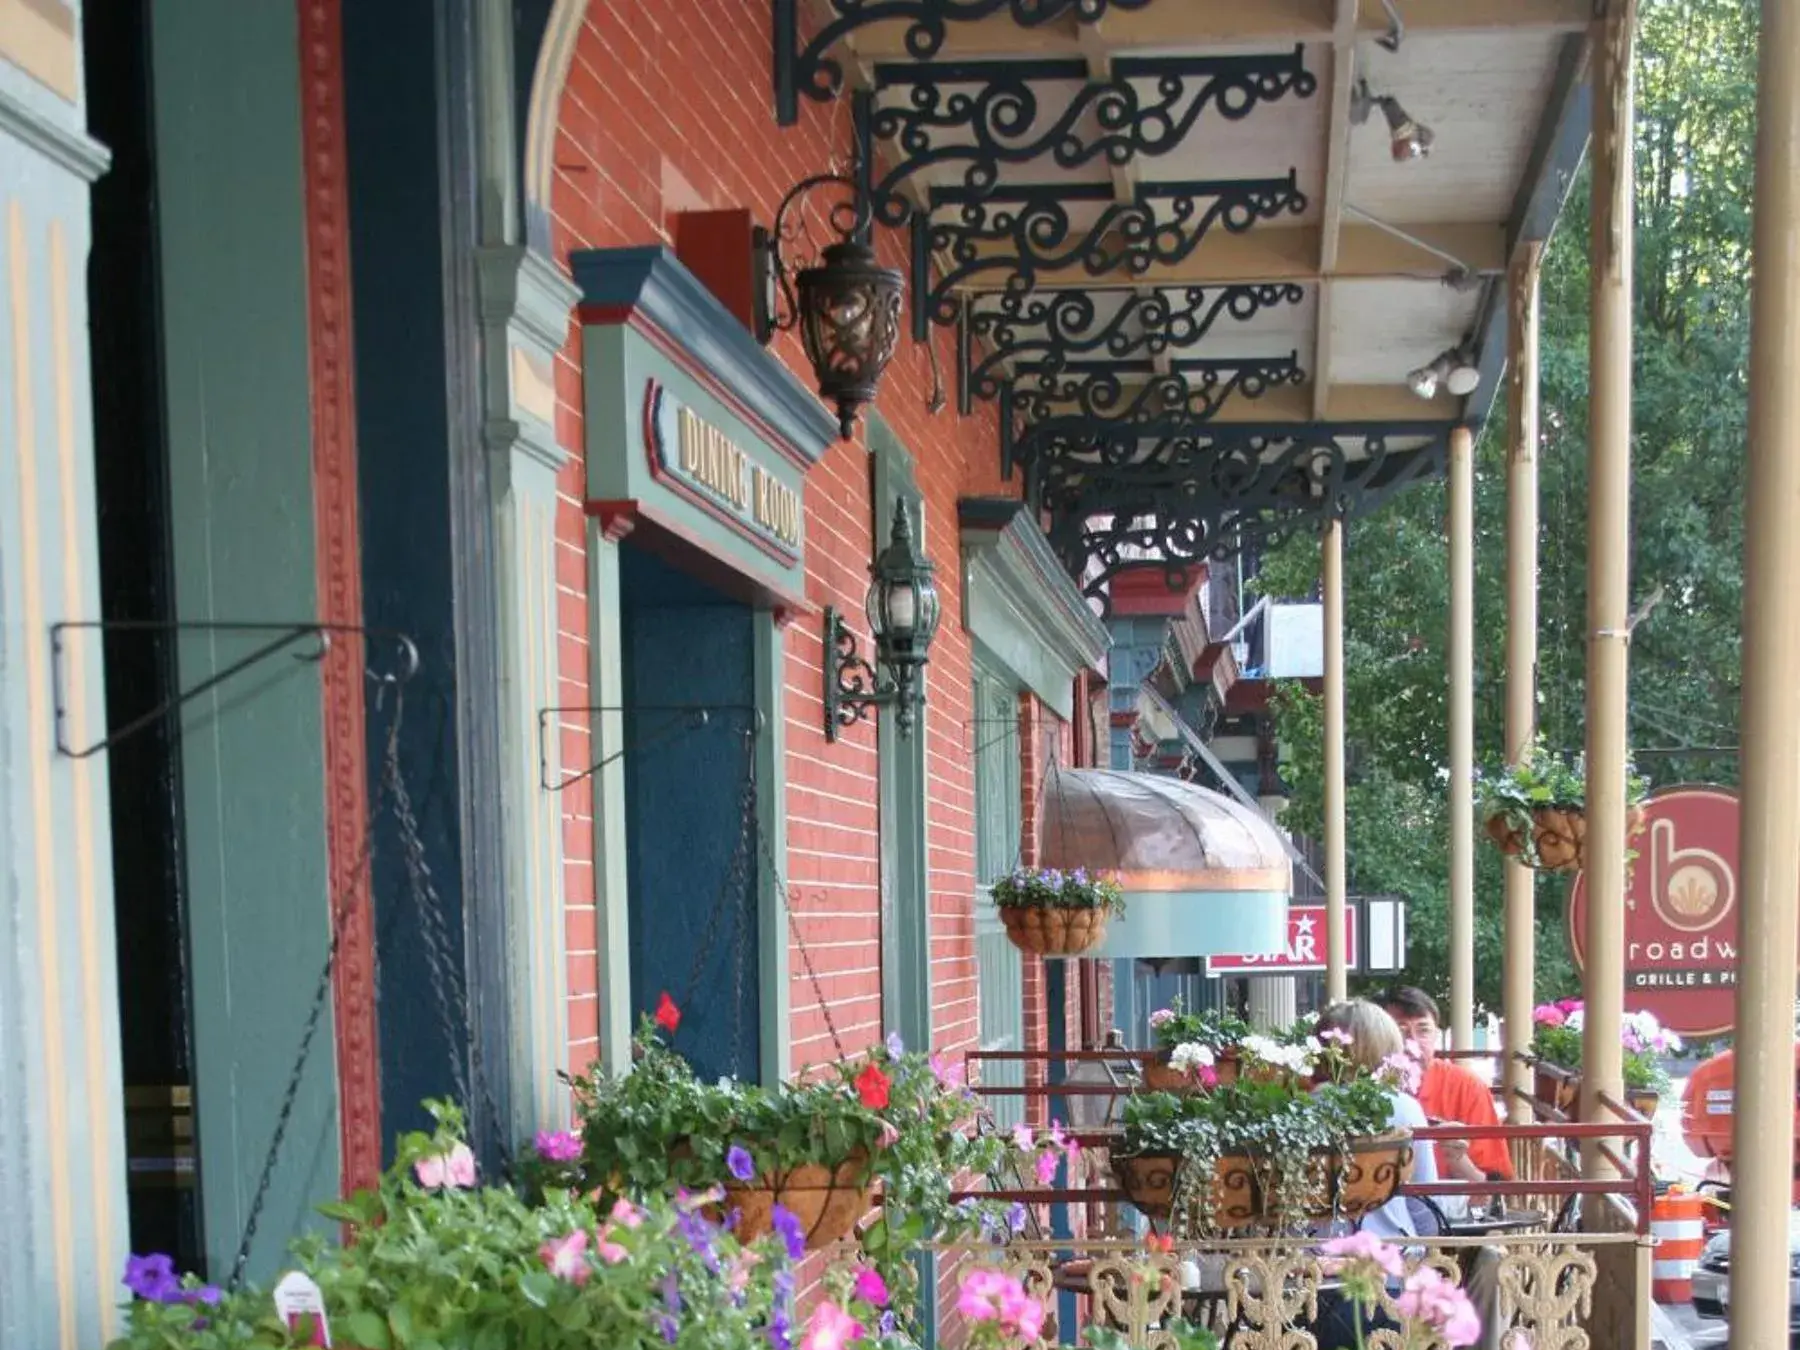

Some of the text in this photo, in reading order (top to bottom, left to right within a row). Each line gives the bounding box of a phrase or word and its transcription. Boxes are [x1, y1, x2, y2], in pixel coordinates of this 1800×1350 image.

[678, 406, 800, 547] DINING ROOM
[1242, 935, 1316, 963] AR
[1636, 972, 1696, 986] GRILLE
[1702, 972, 1712, 984] &
